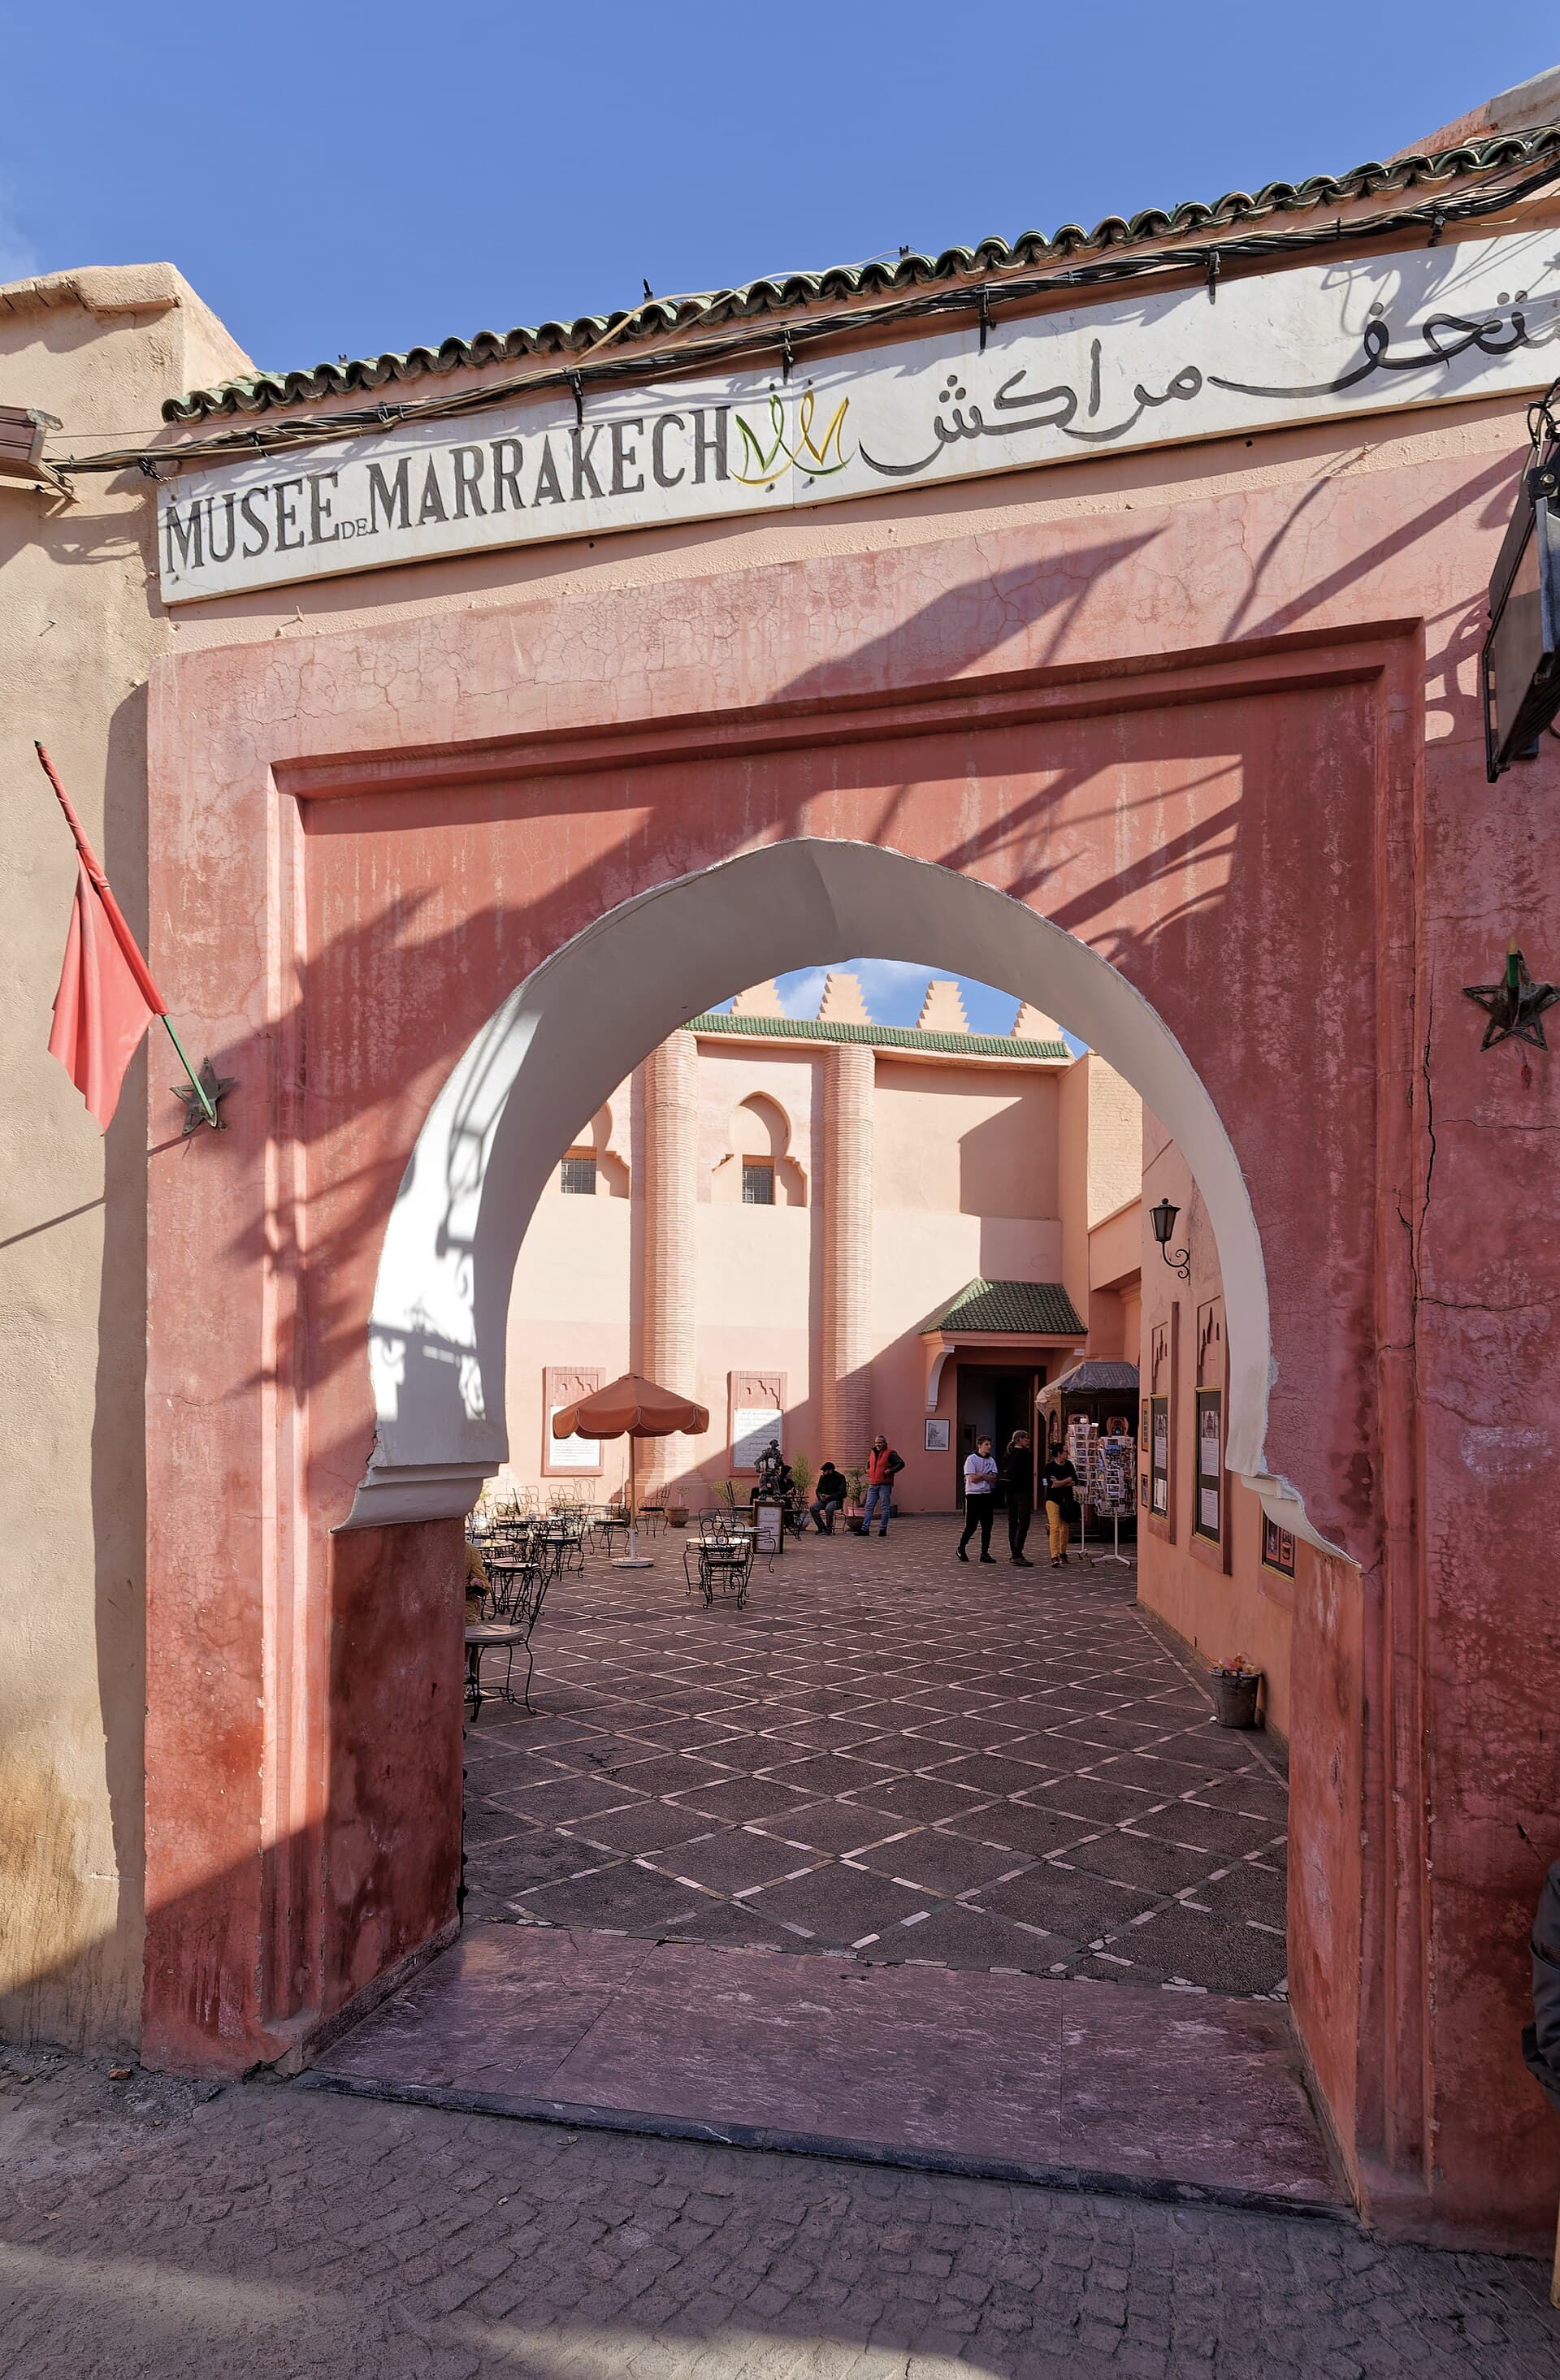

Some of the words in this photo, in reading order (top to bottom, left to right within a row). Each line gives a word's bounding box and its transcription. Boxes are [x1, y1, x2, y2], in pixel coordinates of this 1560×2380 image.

[858, 338, 1202, 477] مراكش
[165, 471, 340, 574] MUSEE
[341, 517, 367, 540] DE
[366, 405, 731, 534] MARRAKECH
